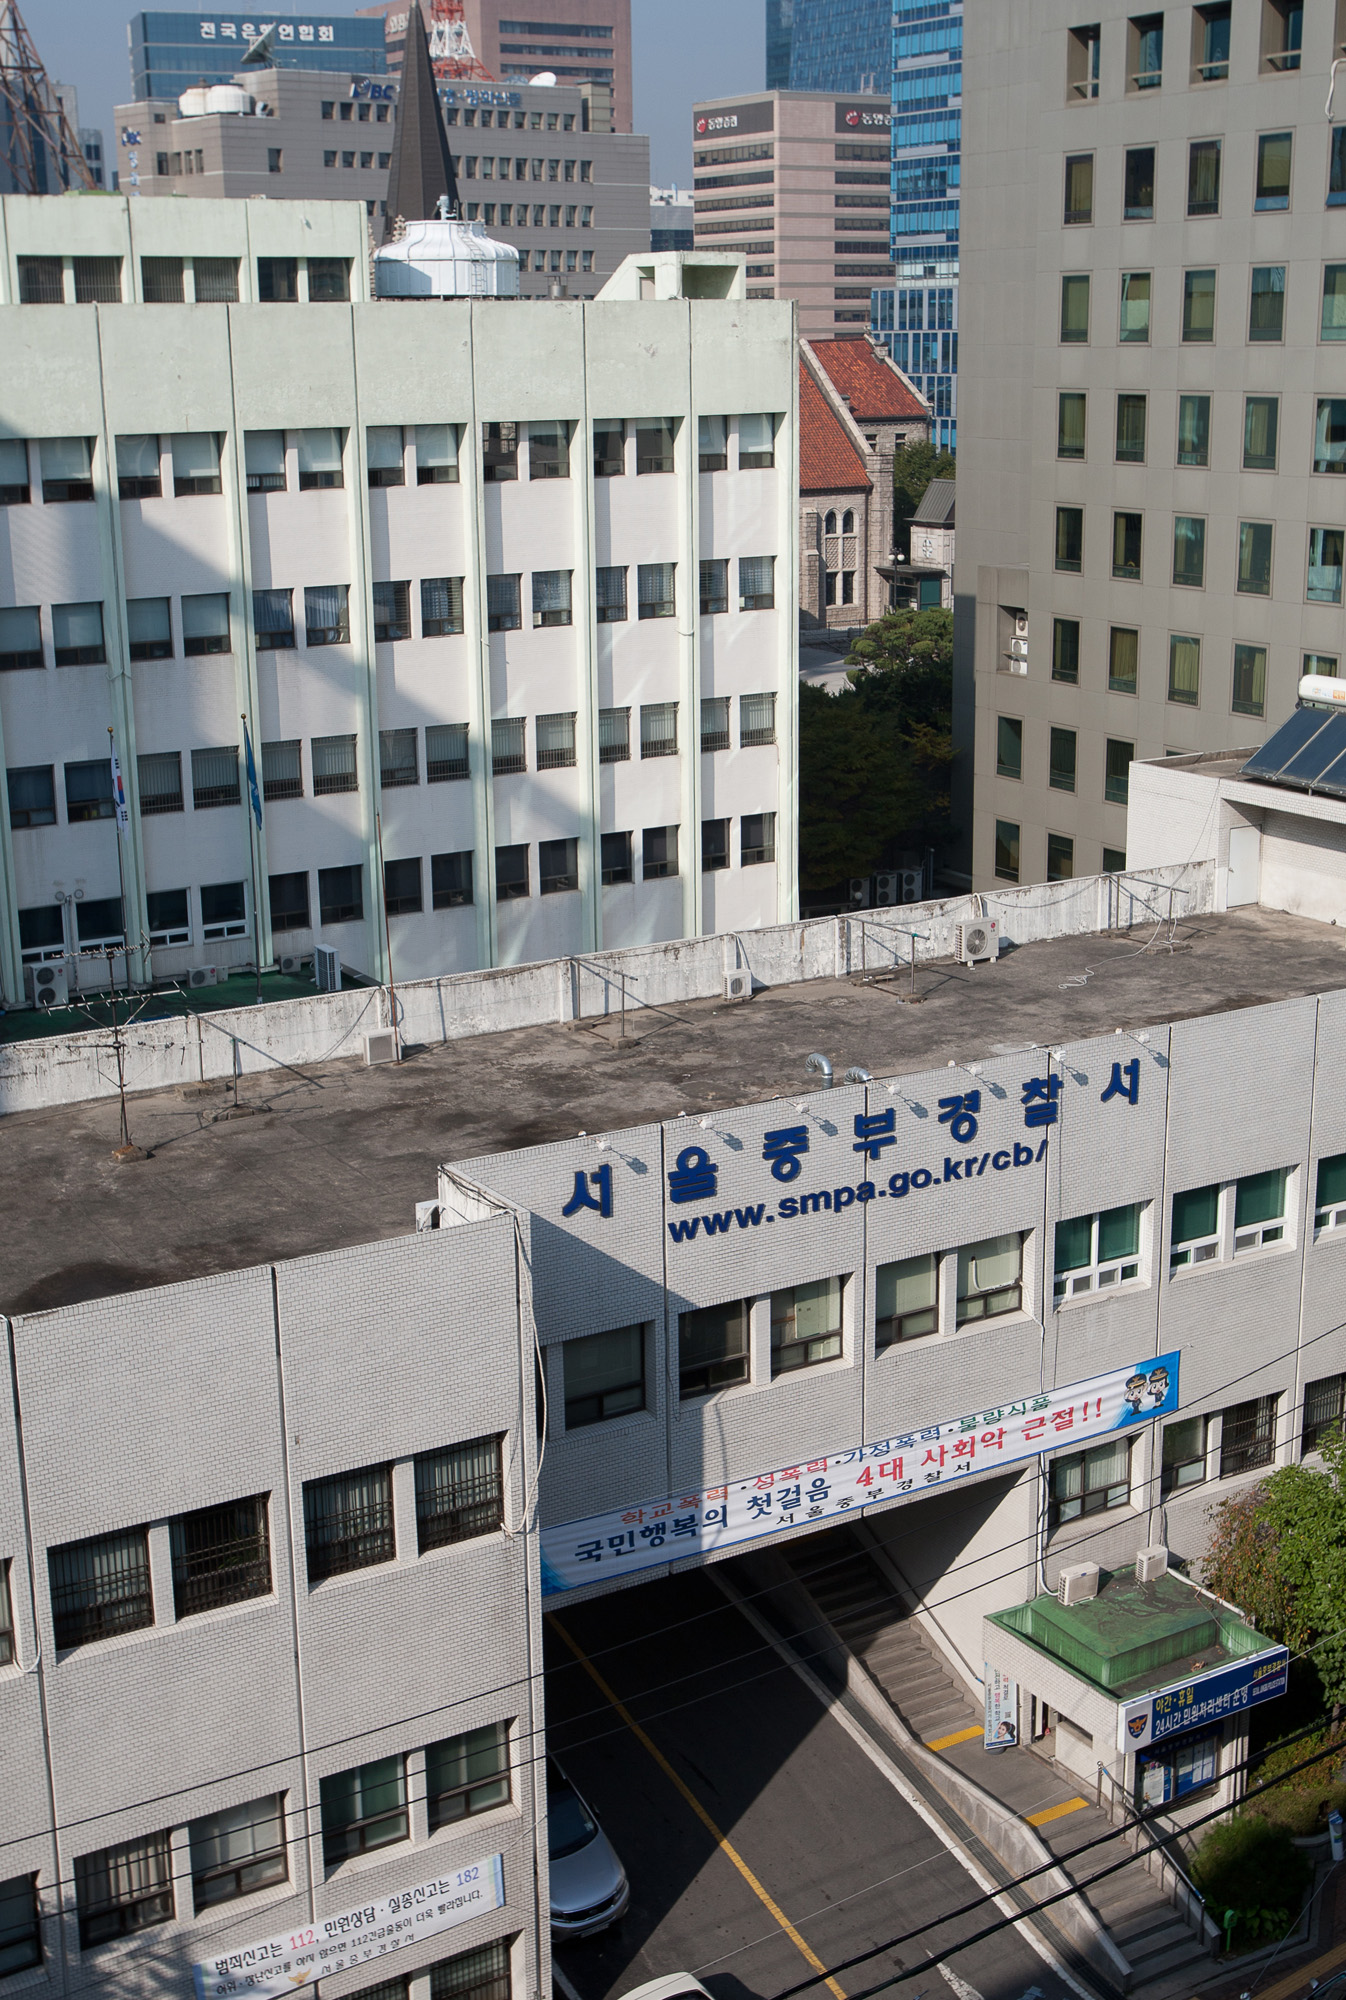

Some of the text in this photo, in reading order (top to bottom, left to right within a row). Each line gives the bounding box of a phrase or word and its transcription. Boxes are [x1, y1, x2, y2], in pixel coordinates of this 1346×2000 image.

[562, 1059, 1139, 1218] 서울중부경찰서
[668, 1139, 1049, 1243] www.smpa.go.kr/cb/
[574, 1397, 1102, 1563] 국민행복의 첫걸음 4대 사회악 근절!!
[776, 1461, 971, 1525] 서울중부경찰서
[1155, 1711, 1181, 1736] 24시간
[1183, 1692, 1231, 1726] 민원처리센터
[1232, 1686, 1249, 1707] 운영
[215, 1866, 480, 1976] 범죄신고는 112, 민원상담 실종신고는 182
[319, 1941, 347, 1960] 않으면
[351, 1917, 412, 1947] 112긴급출동이
[416, 1908, 434, 1923] 더욱
